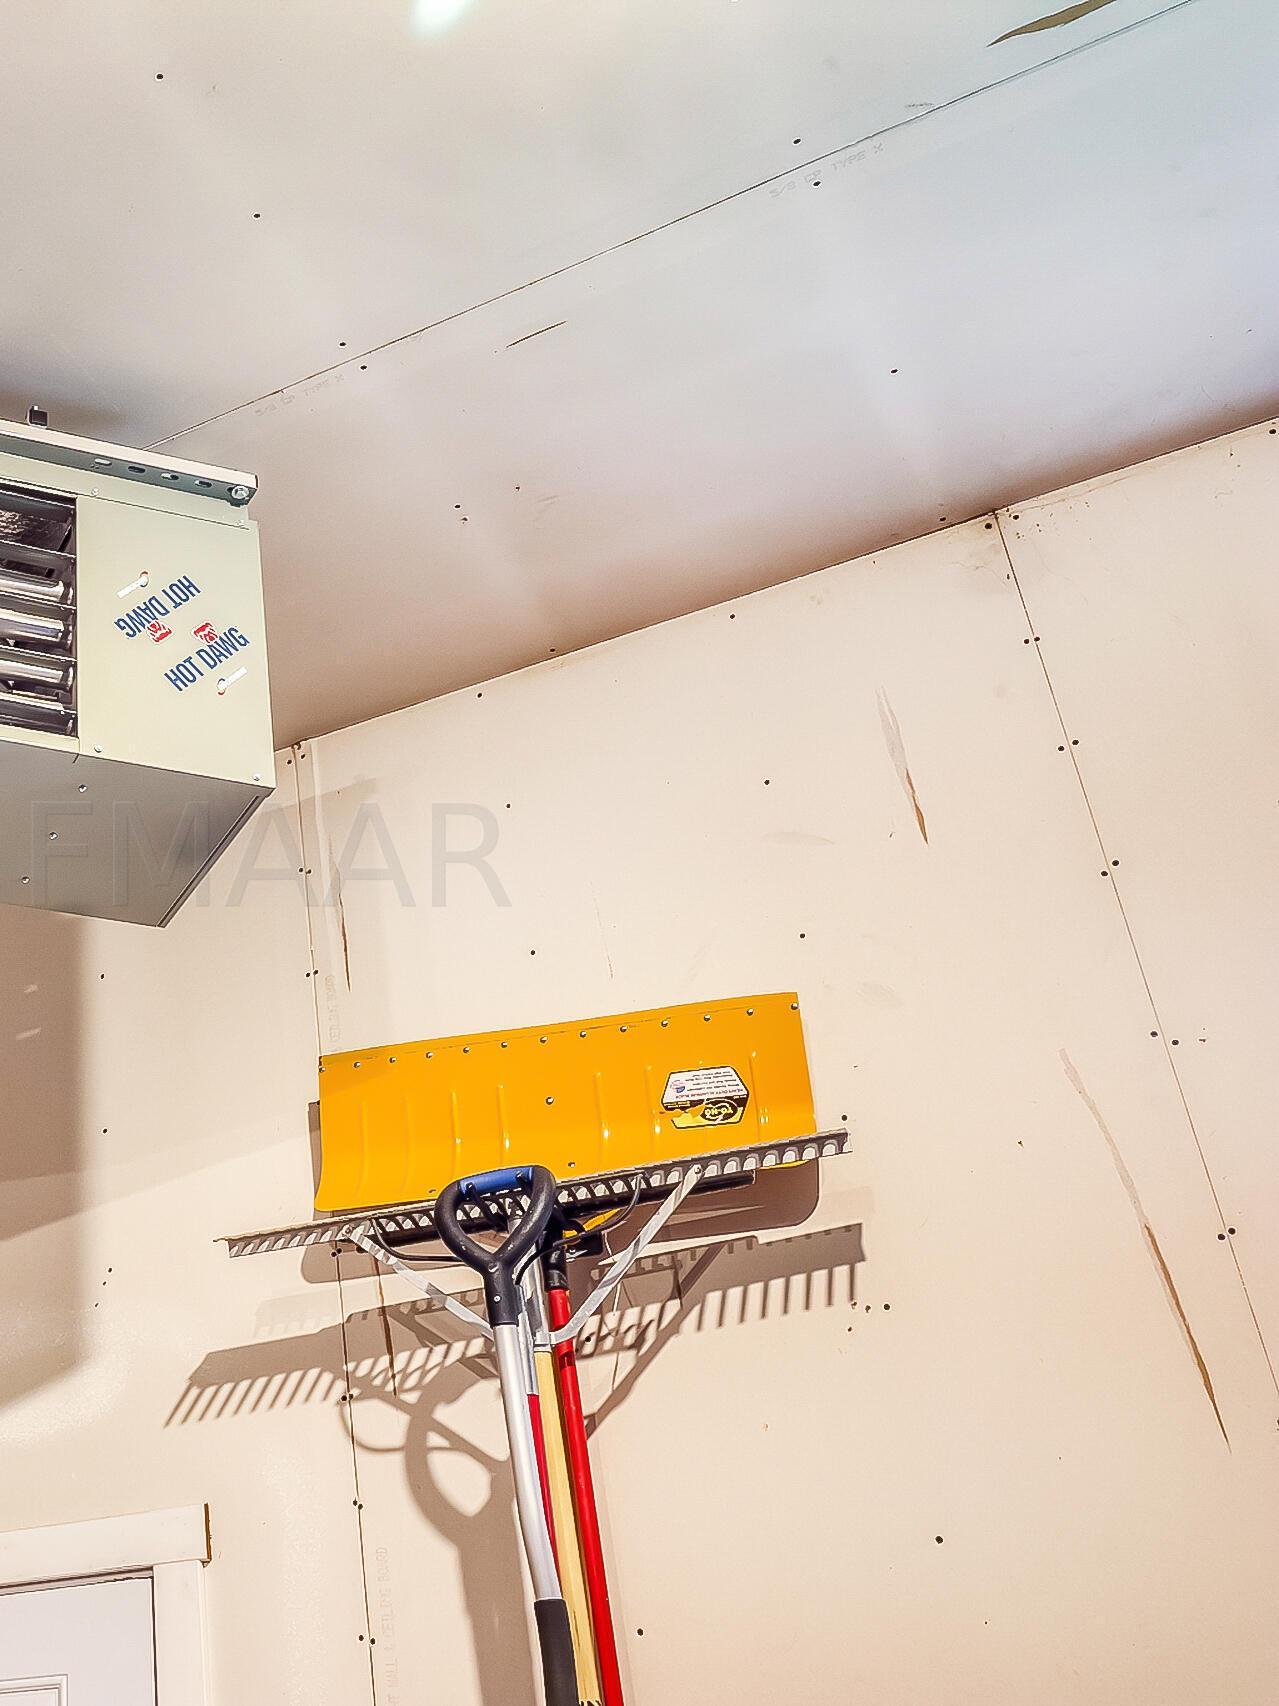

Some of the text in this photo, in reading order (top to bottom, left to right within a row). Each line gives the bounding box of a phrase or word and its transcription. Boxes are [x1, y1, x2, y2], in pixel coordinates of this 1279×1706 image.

[113, 574, 202, 639] HOT DAWG
[163, 626, 251, 693] HOT DAWG
[374, 1546, 391, 1582] BOARD
